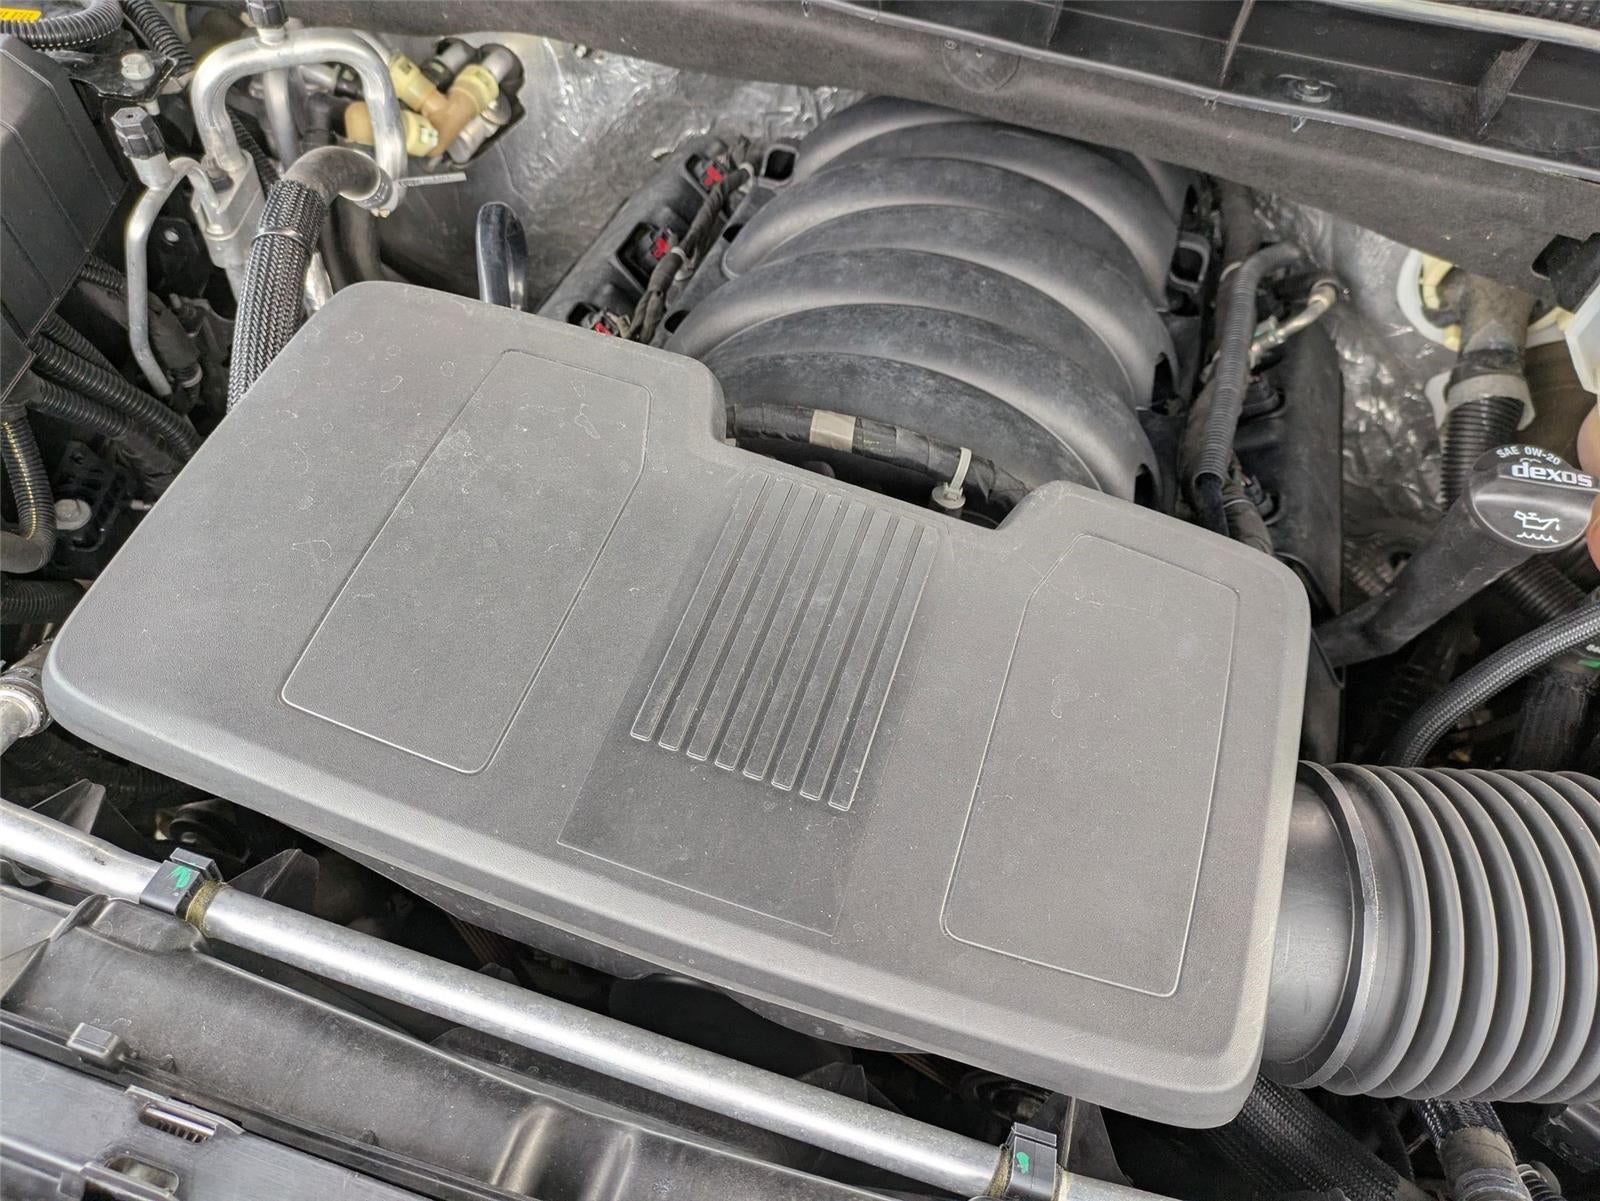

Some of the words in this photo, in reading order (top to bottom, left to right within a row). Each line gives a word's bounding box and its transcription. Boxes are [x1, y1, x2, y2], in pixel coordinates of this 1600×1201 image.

[1496, 446, 1520, 458] SAE
[1523, 446, 1561, 465] 0W-20
[1511, 461, 1592, 487] dexos
